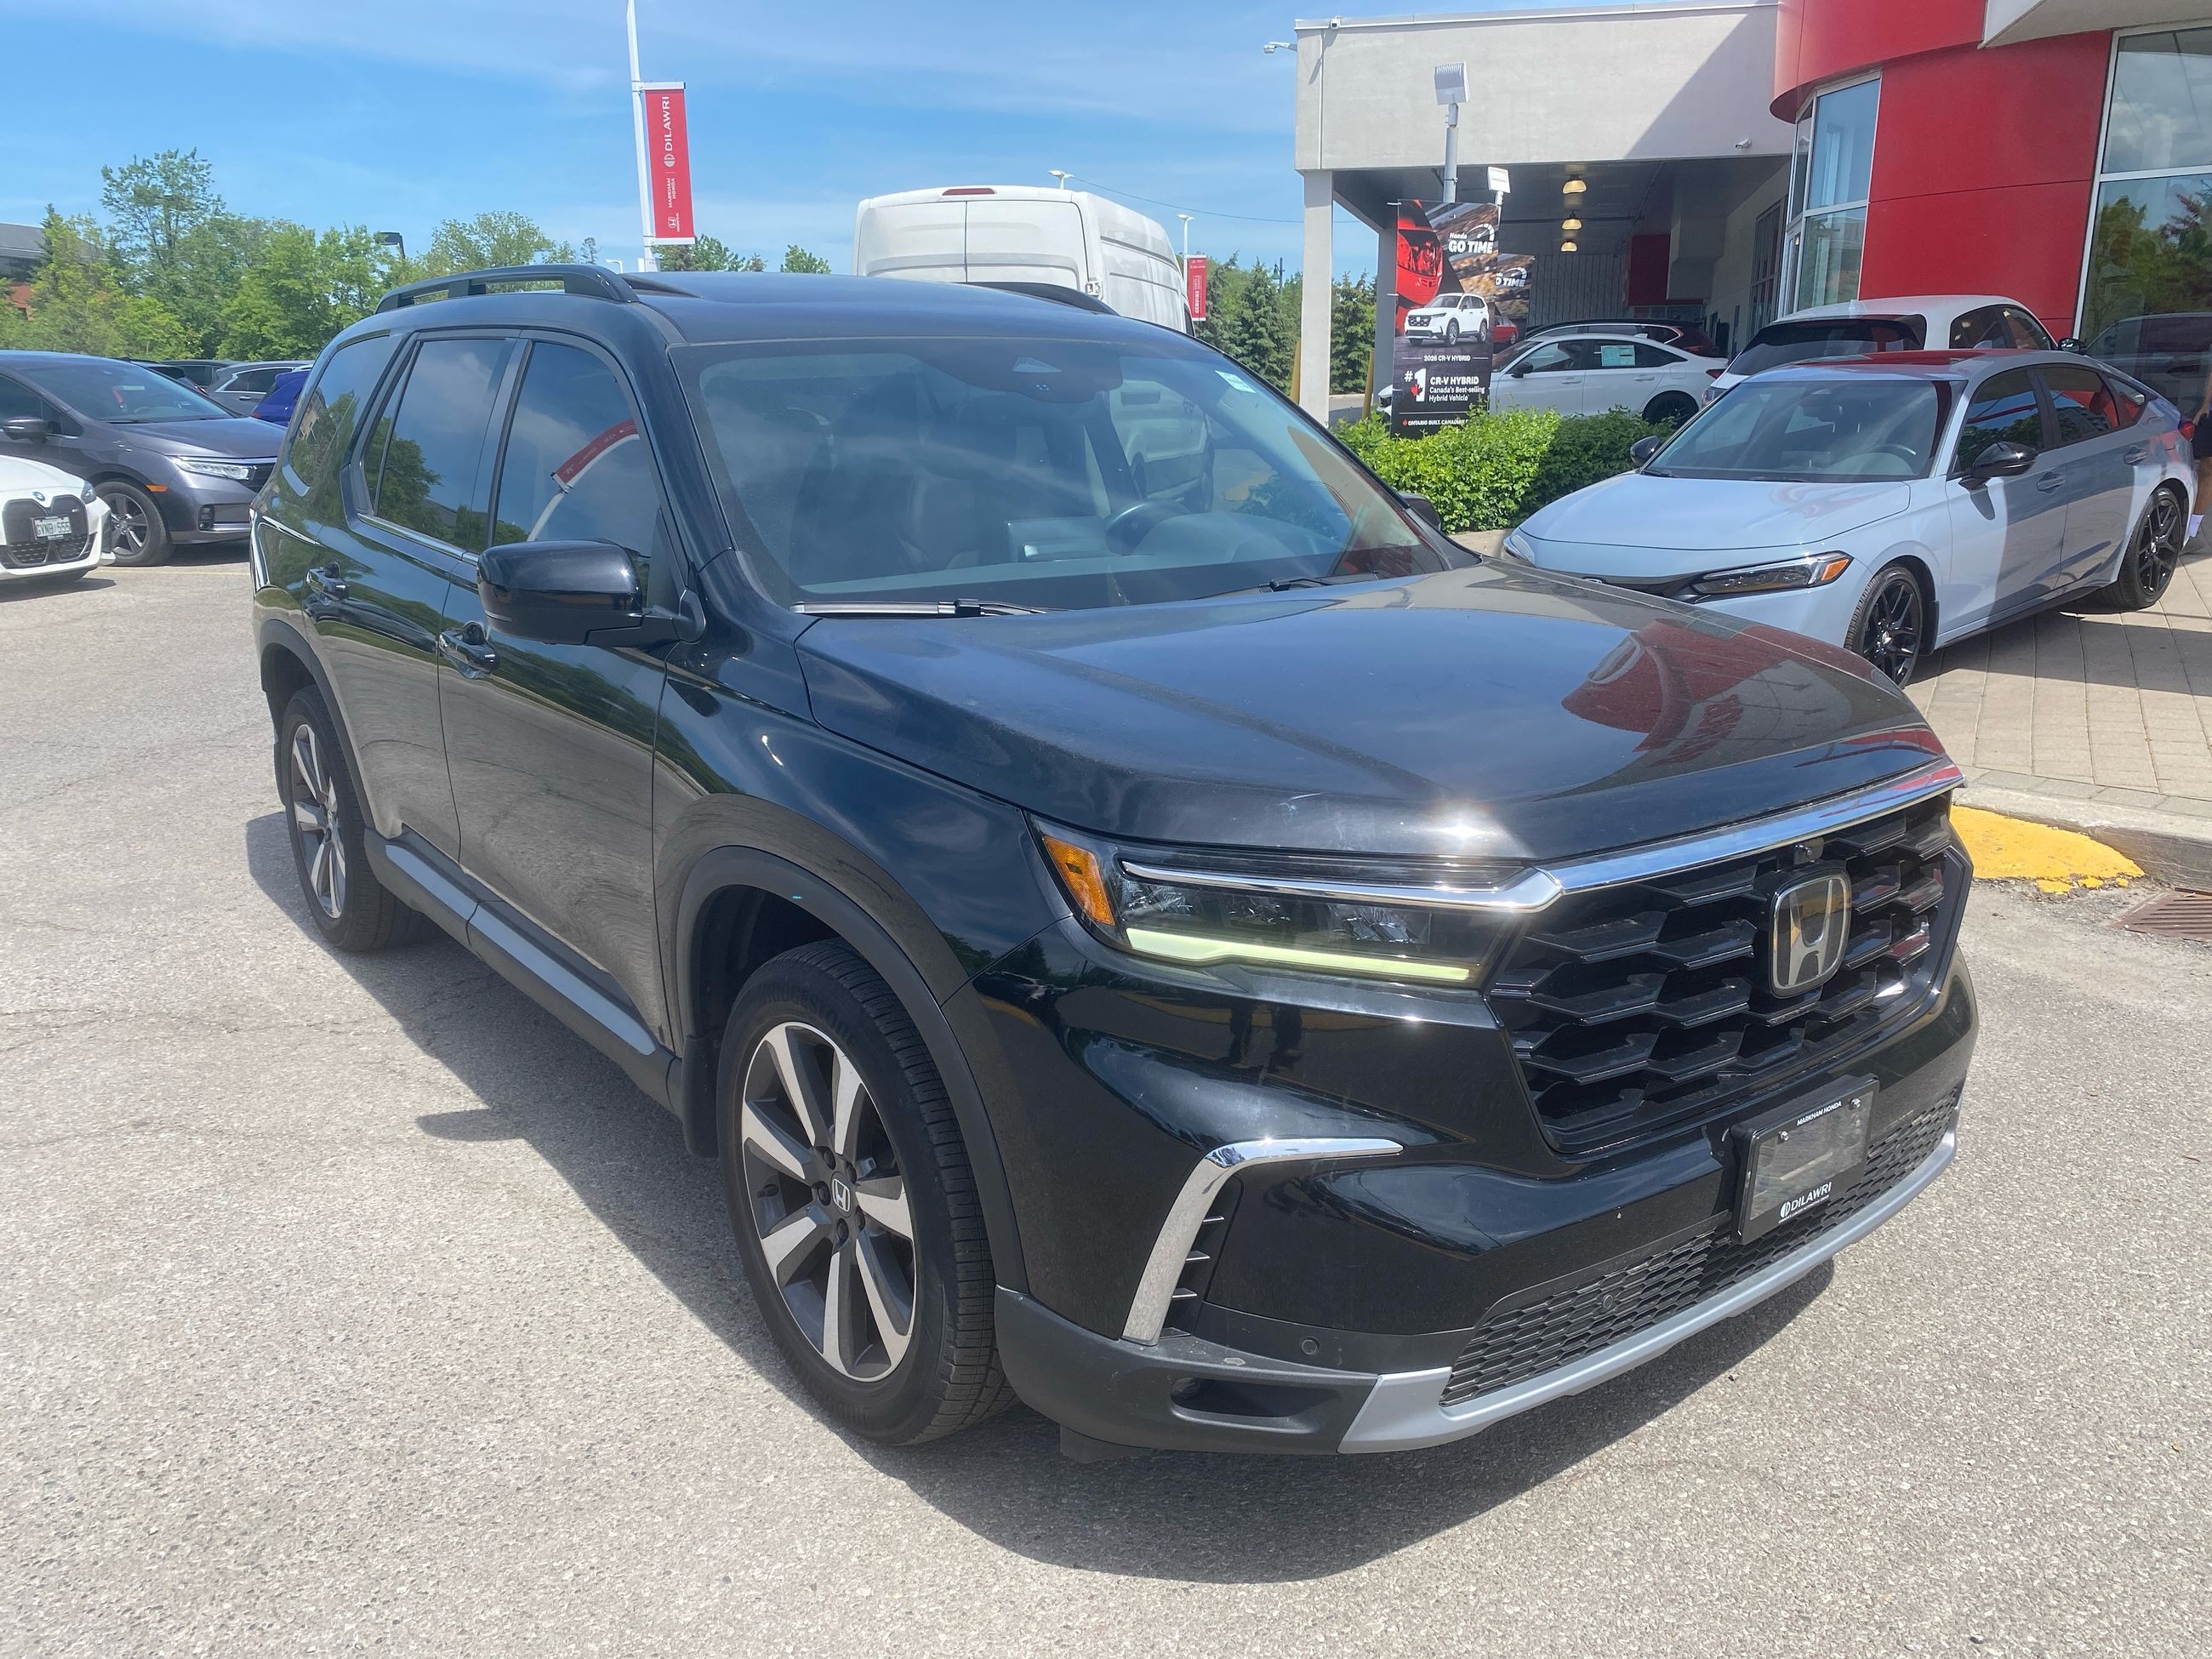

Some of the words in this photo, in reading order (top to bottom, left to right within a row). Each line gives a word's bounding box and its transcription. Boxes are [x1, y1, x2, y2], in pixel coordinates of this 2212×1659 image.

[662, 96, 673, 151] DILAWRI
[1448, 240, 1467, 253] GO
[1467, 241, 1494, 254] TIME
[1503, 277, 1525, 287] TIME
[1429, 376, 1449, 385] CR-V
[1450, 376, 1479, 385] HYBRID
[1455, 386, 1485, 395] Best-selling
[1428, 394, 1448, 403] Hybrid
[57, 522, 71, 533] 555
[1796, 1109, 1824, 1126] MARKHAM
[1823, 1100, 1842, 1115] HONDA
[1791, 1182, 1832, 1211] DILAWRI
